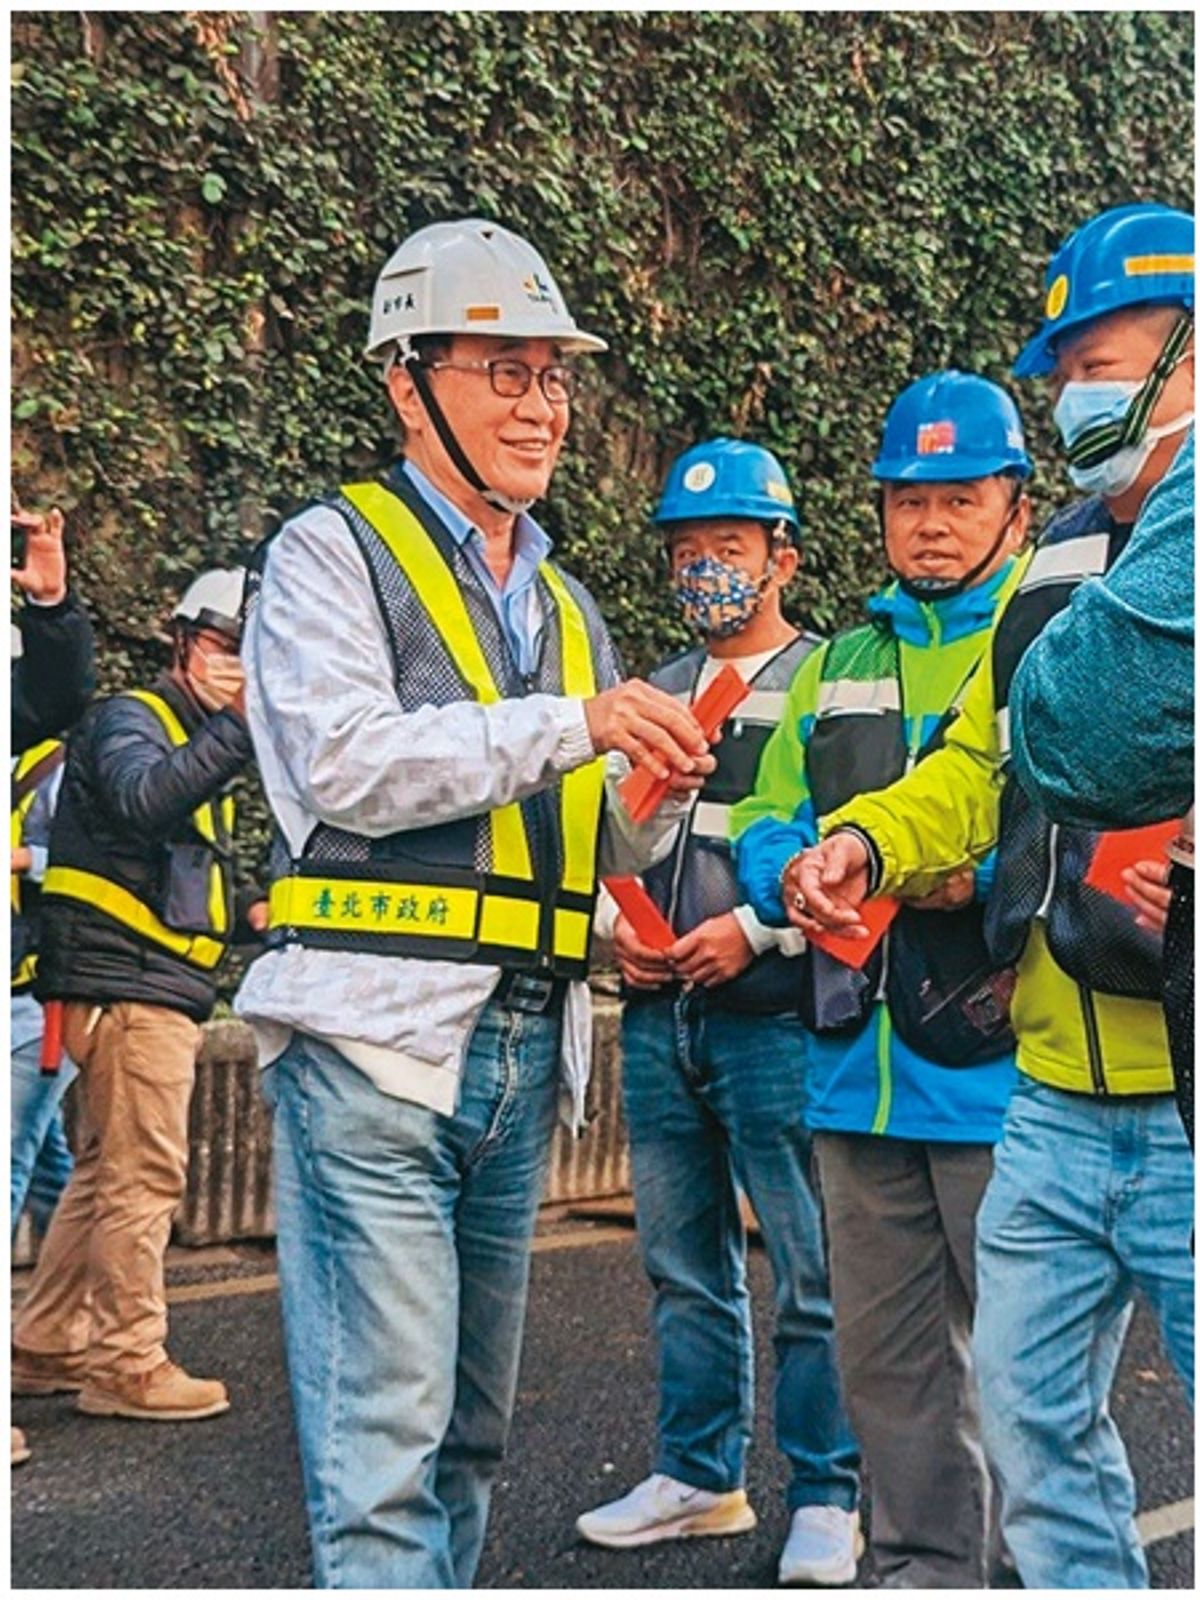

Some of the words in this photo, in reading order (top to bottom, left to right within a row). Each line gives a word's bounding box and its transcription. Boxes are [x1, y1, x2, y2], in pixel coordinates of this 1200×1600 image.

[313, 888, 448, 925] 臺北市政府
